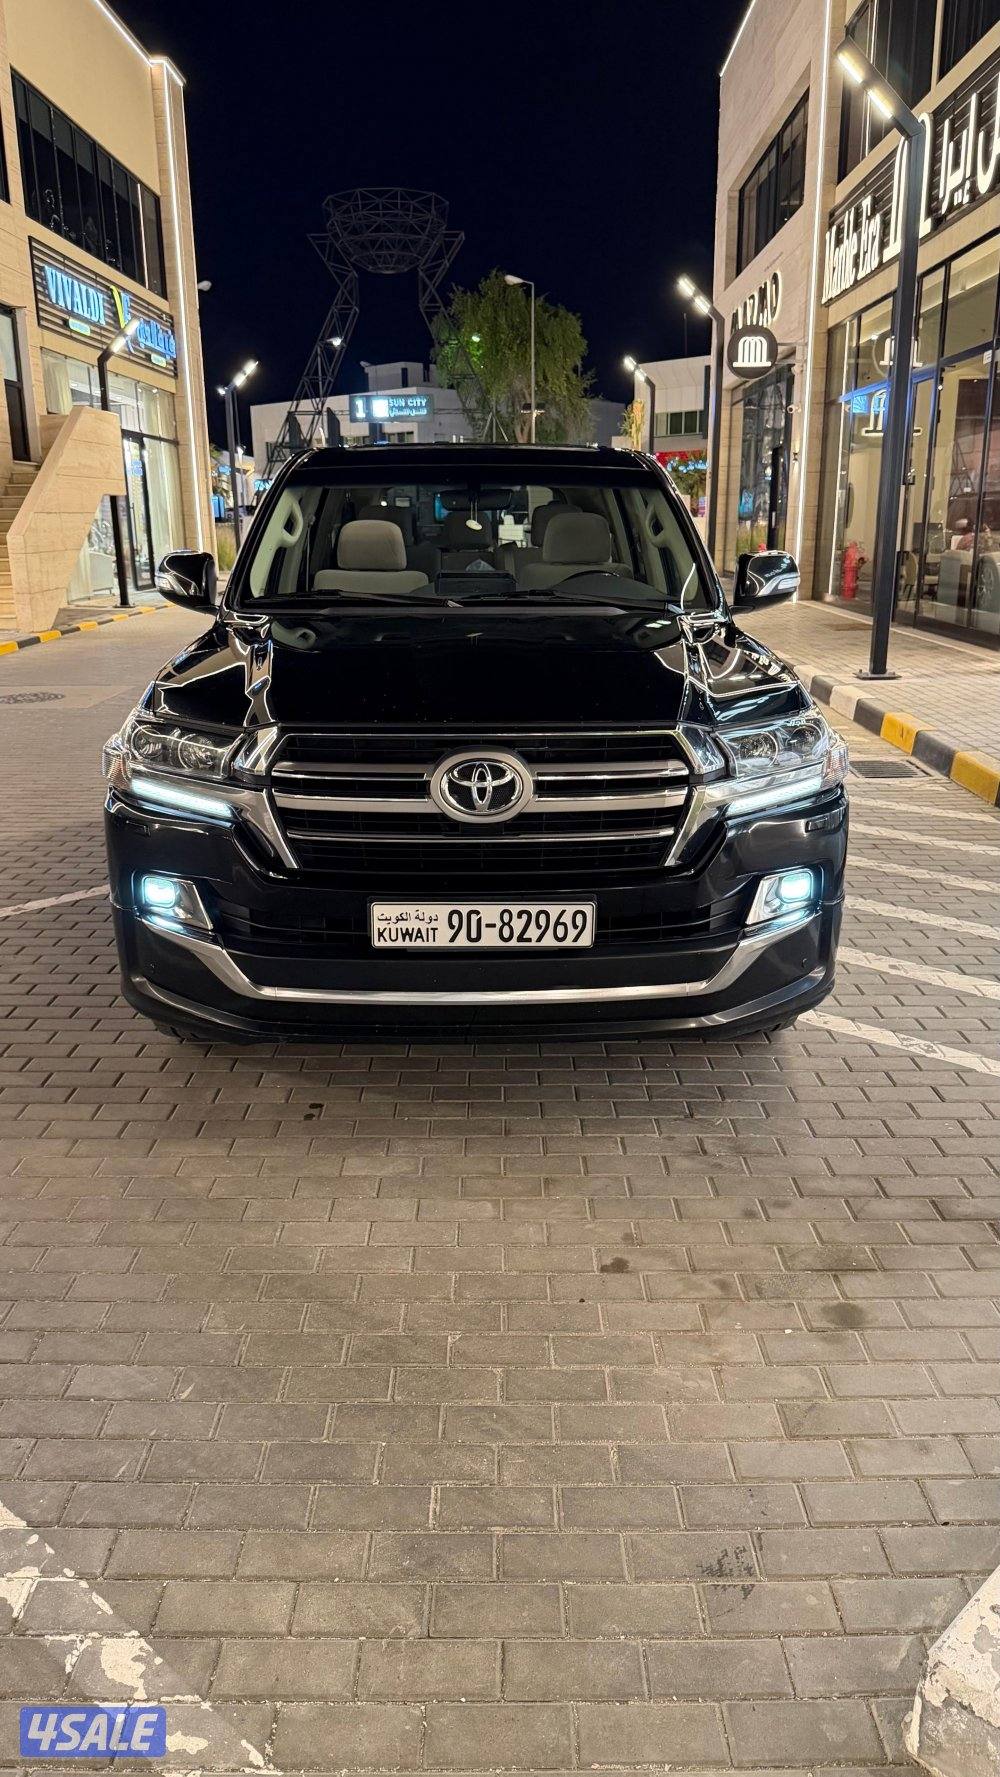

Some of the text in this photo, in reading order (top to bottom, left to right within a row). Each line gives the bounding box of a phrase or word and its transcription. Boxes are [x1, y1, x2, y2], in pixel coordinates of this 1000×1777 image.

[821, 206, 858, 304] Marble
[857, 195, 881, 280] Era
[44, 265, 106, 326] VIVALDI
[389, 397, 426, 407] SUN CITY
[377, 909, 439, 925] دولة الكويت
[447, 908, 588, 943] 90-82969
[377, 927, 439, 943] KUWAIT
